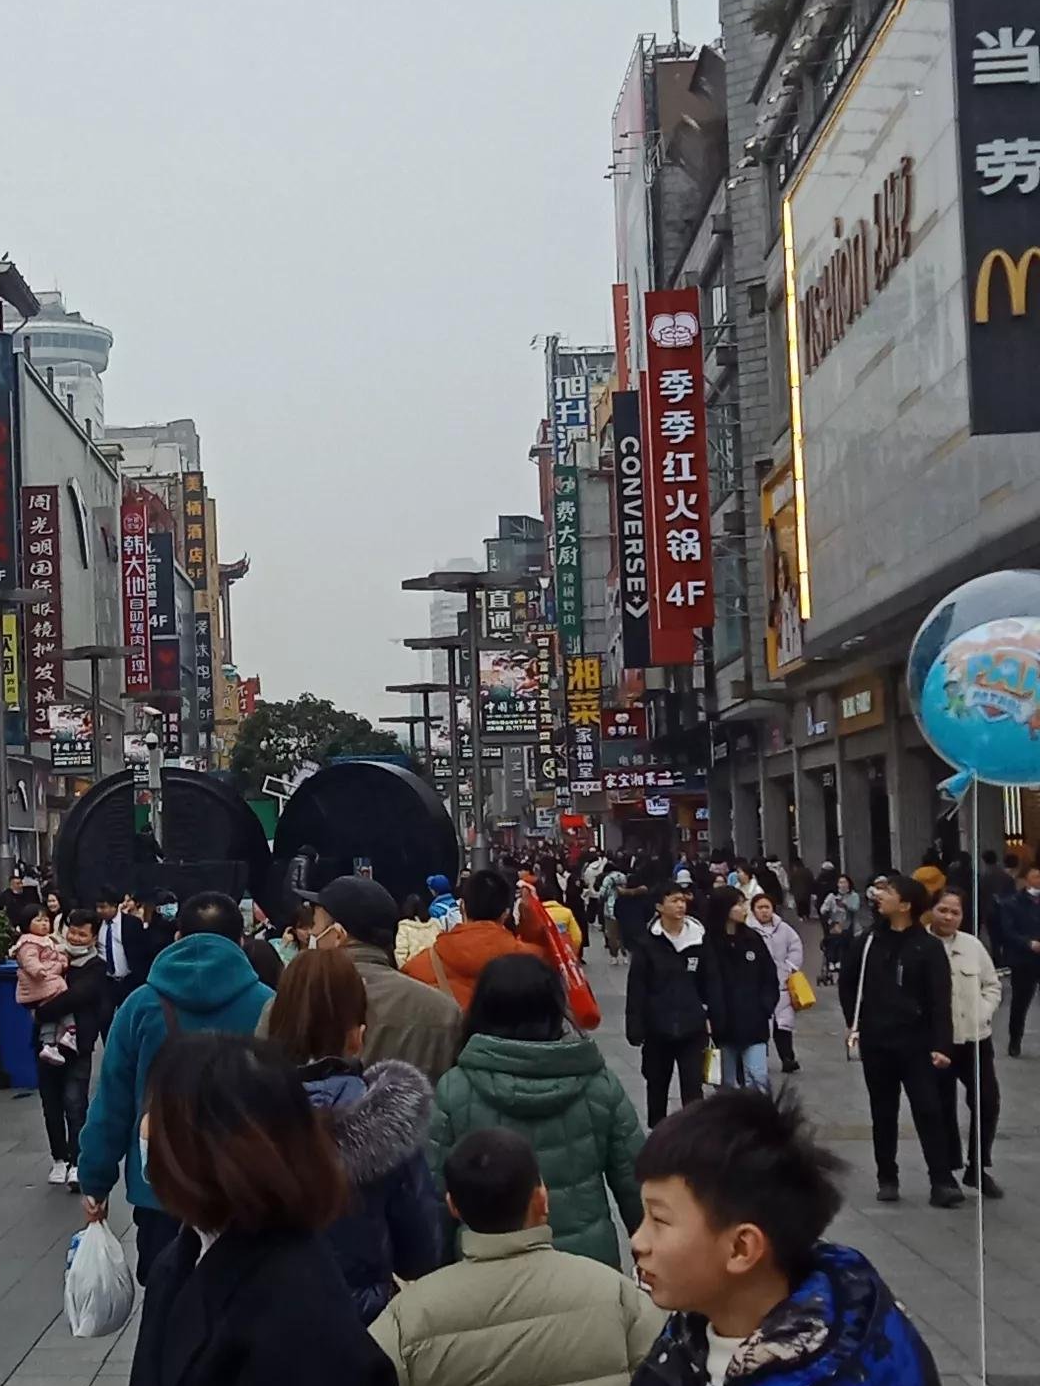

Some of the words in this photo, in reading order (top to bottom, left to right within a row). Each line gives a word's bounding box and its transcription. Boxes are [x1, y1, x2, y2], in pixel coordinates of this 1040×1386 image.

[660, 368, 702, 562] 季季红火锅
[556, 501, 579, 566] 费大厨
[620, 436, 646, 593] CONVERSE
[666, 580, 707, 607] 4F
[568, 657, 601, 726] 湘菜
